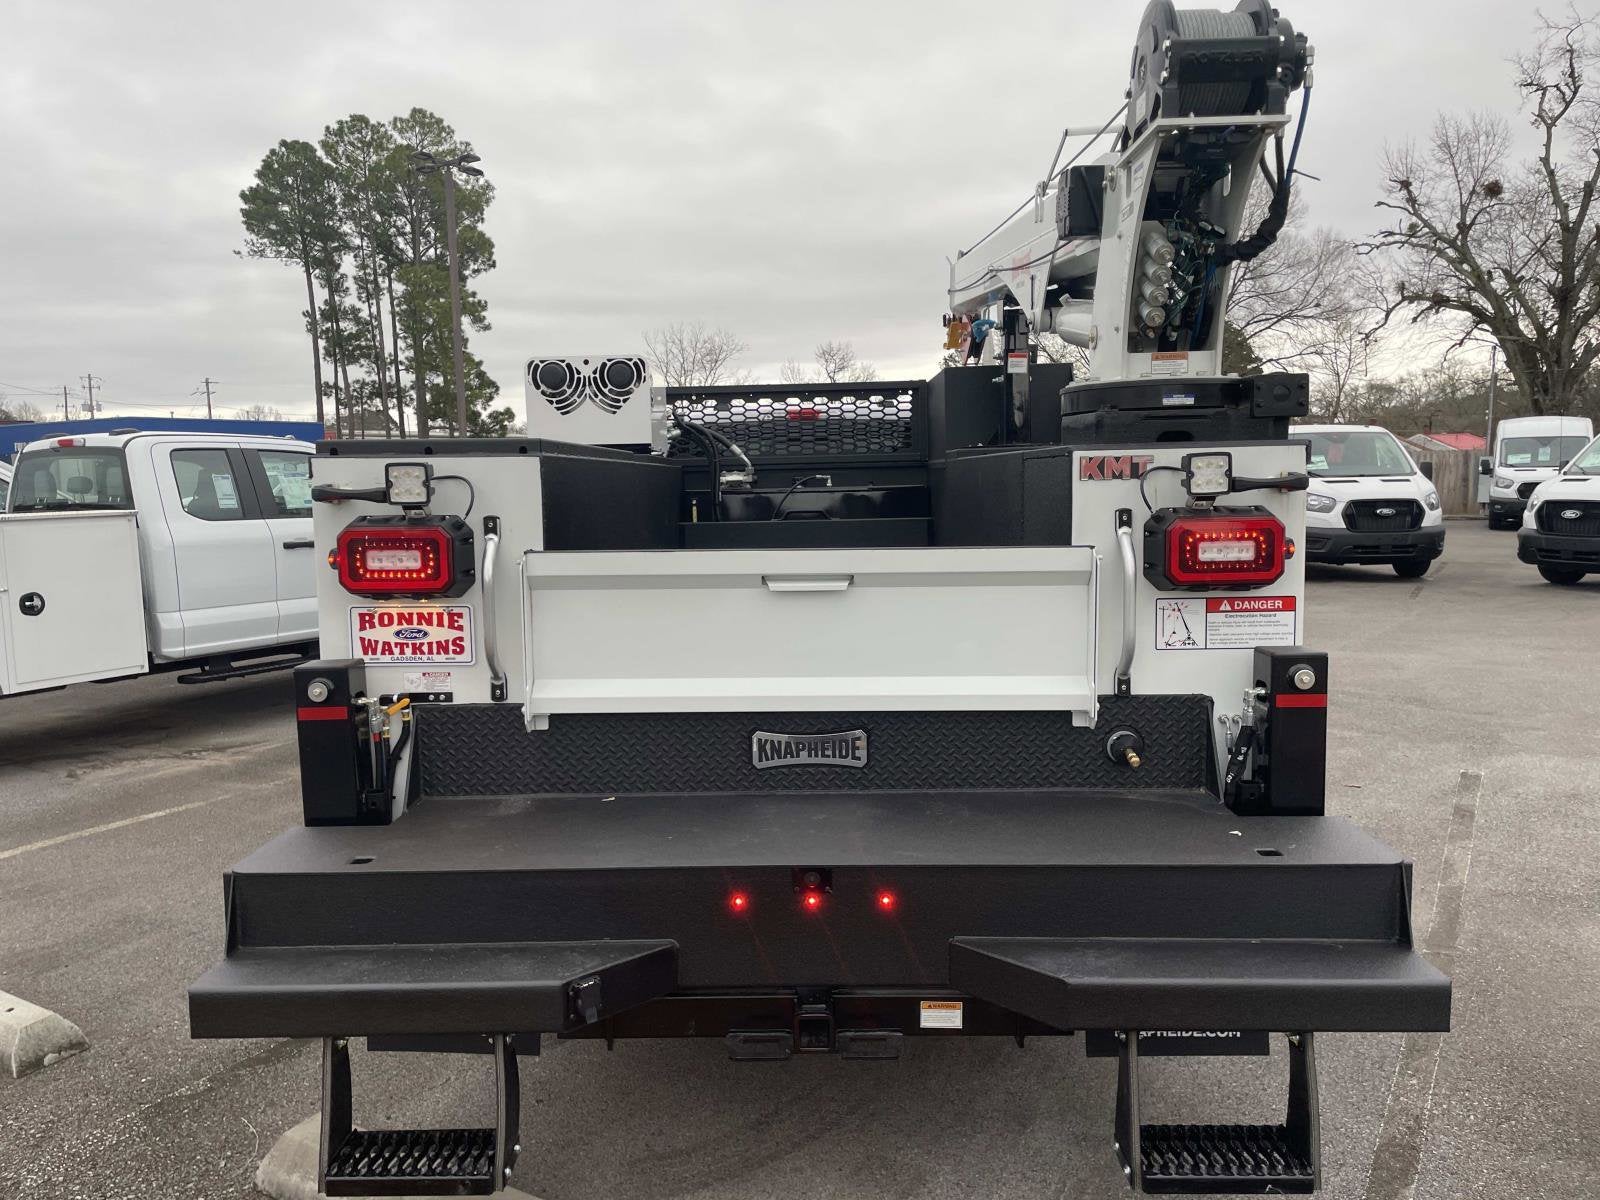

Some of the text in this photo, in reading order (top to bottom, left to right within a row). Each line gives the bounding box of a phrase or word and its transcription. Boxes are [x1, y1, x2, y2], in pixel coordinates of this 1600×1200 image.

[1080, 455, 1154, 481] KMT
[1234, 600, 1283, 610] DANGER
[358, 612, 464, 632] RONNIE
[397, 629, 426, 639] Ford
[359, 636, 465, 656] WATKINS
[757, 736, 862, 762] KNAPHEIDE
